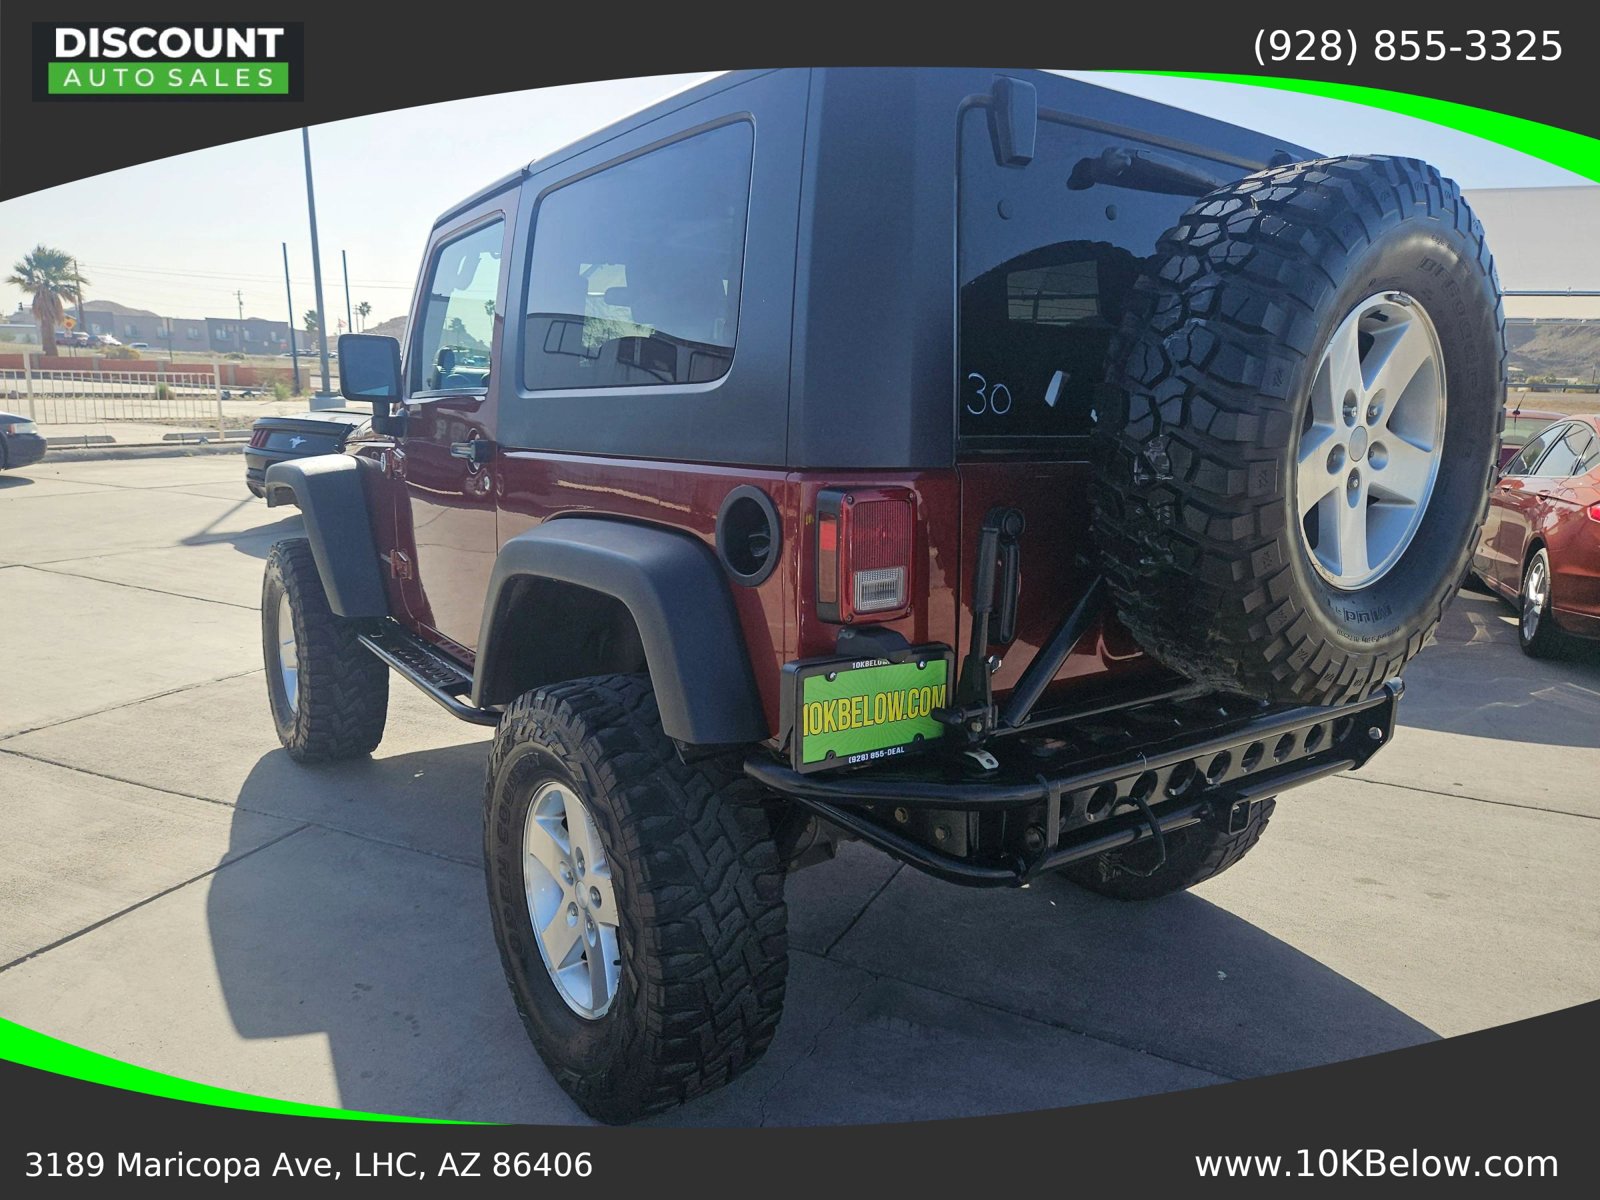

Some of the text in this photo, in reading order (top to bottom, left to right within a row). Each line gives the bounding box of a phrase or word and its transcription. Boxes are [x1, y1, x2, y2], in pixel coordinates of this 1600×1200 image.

[966, 372, 1012, 415] 30
[803, 684, 947, 737] 10KBELOW.COM
[848, 746, 905, 764] (928) 855-DEAL
